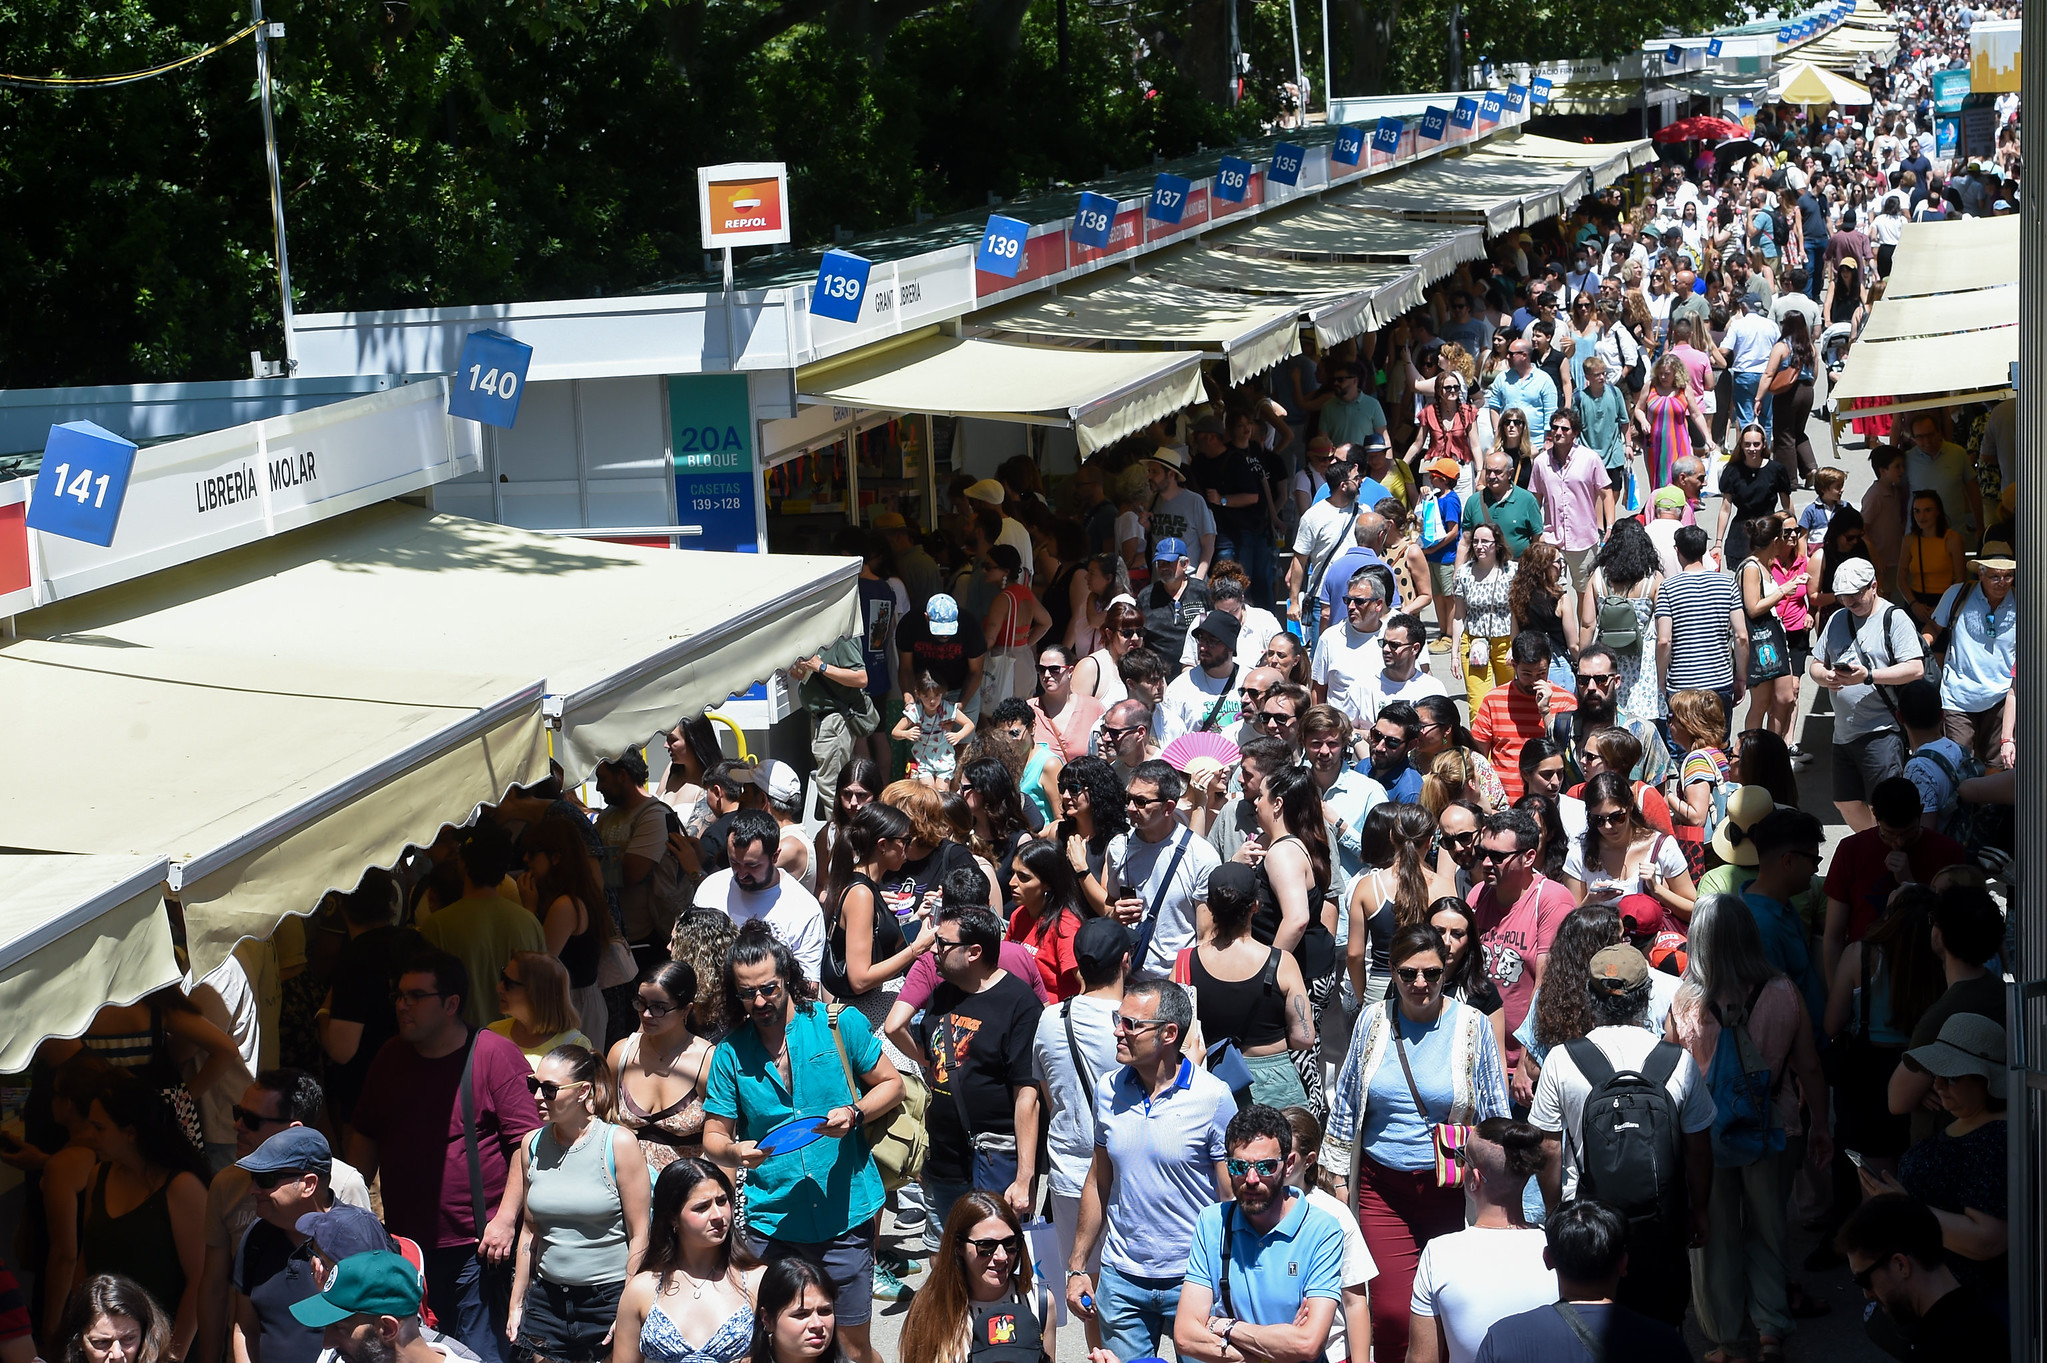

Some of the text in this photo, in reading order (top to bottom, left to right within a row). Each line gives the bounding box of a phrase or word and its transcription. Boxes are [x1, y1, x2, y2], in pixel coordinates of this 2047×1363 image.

[1507, 92, 1522, 104] 129
[1533, 85, 1548, 97] 128
[1455, 107, 1472, 121] 131
[1483, 100, 1500, 113] 130
[1424, 116, 1442, 130] 132
[1378, 128, 1396, 143] 133
[1337, 138, 1358, 154] 134
[1275, 155, 1298, 173] 135
[1220, 169, 1244, 188] 136
[1156, 189, 1181, 208] 137
[725, 217, 767, 229] REPSOL
[1080, 209, 1107, 232] 138
[987, 234, 1019, 259] 139
[824, 274, 860, 300] 139
[875, 289, 894, 313] GRANT
[468, 363, 517, 400] 140
[681, 426, 743, 452] 20A
[687, 453, 738, 467] BLOQUE
[54, 462, 111, 509] 141
[195, 451, 317, 513] LIBRERÍA MOLAR
[690, 482, 740, 495] CASETAS
[1503, 930, 1527, 951] ROLL
